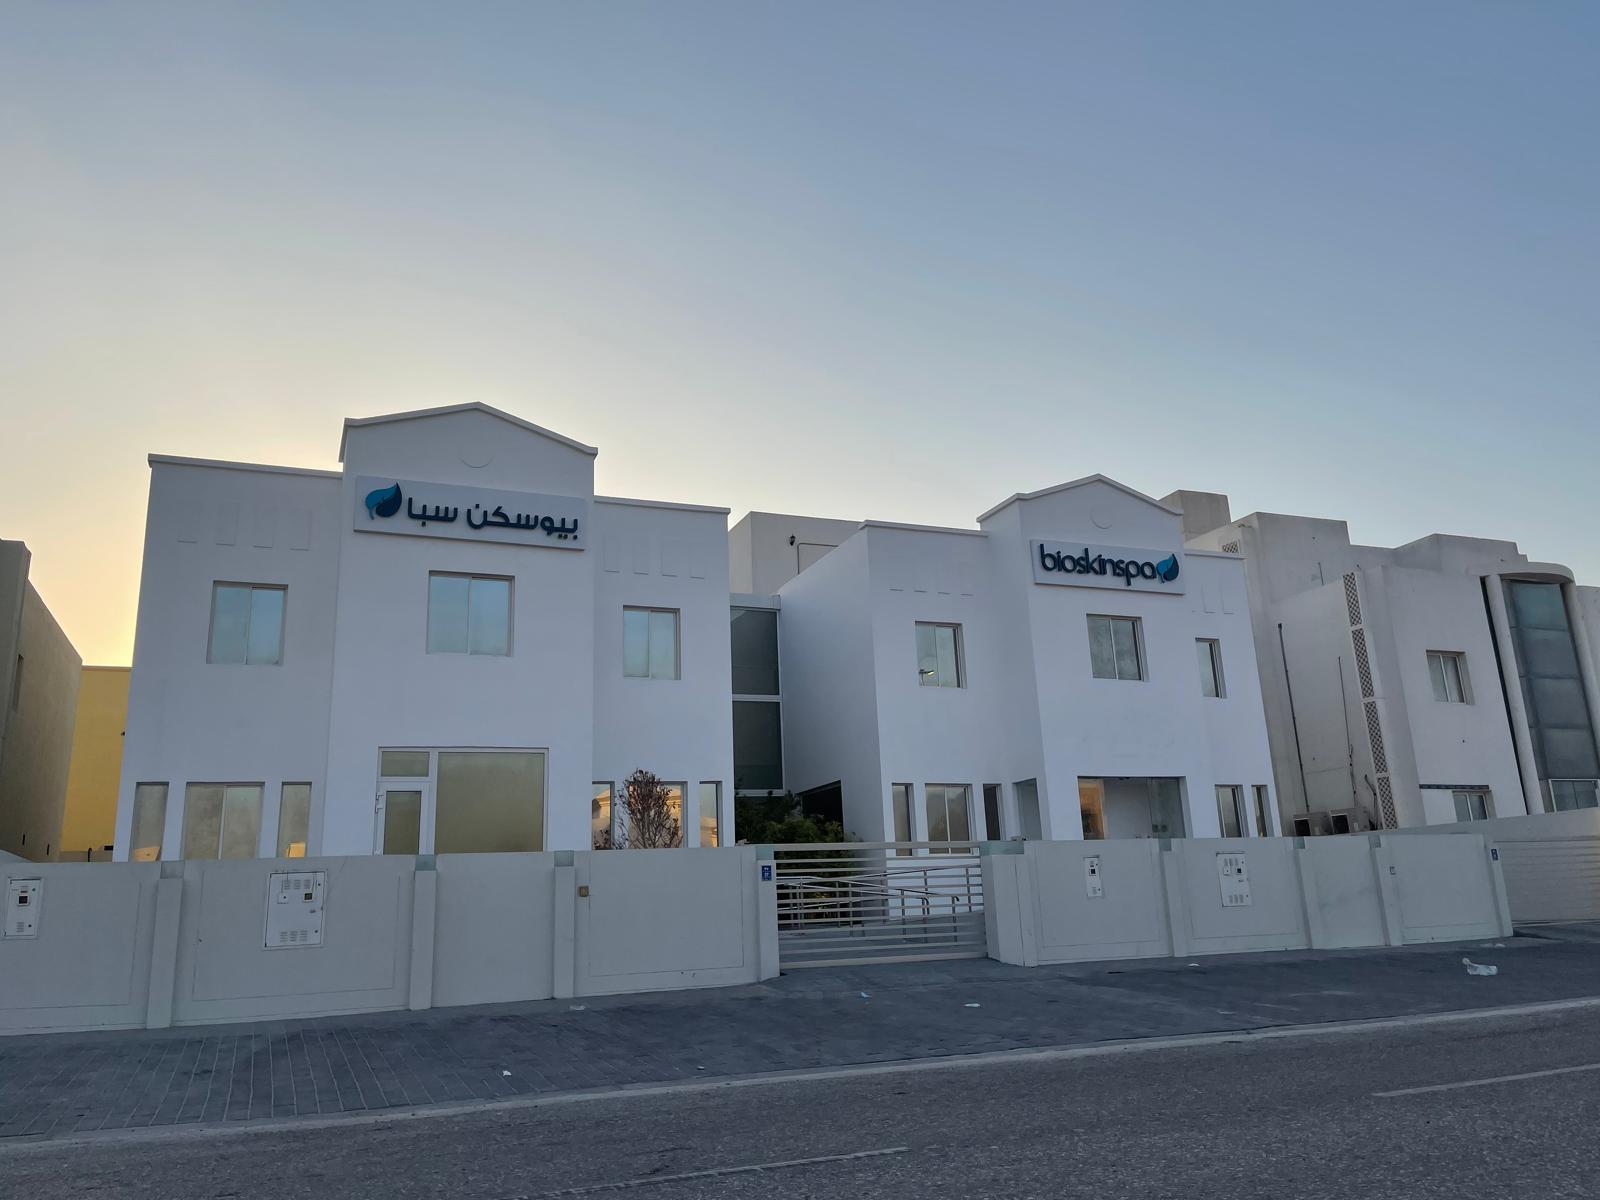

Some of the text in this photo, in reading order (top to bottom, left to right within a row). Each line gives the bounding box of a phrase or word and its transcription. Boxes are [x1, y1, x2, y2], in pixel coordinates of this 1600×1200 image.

[407, 497, 579, 540] بيوسكن سبا
[1039, 543, 1157, 586] bioskinspa
